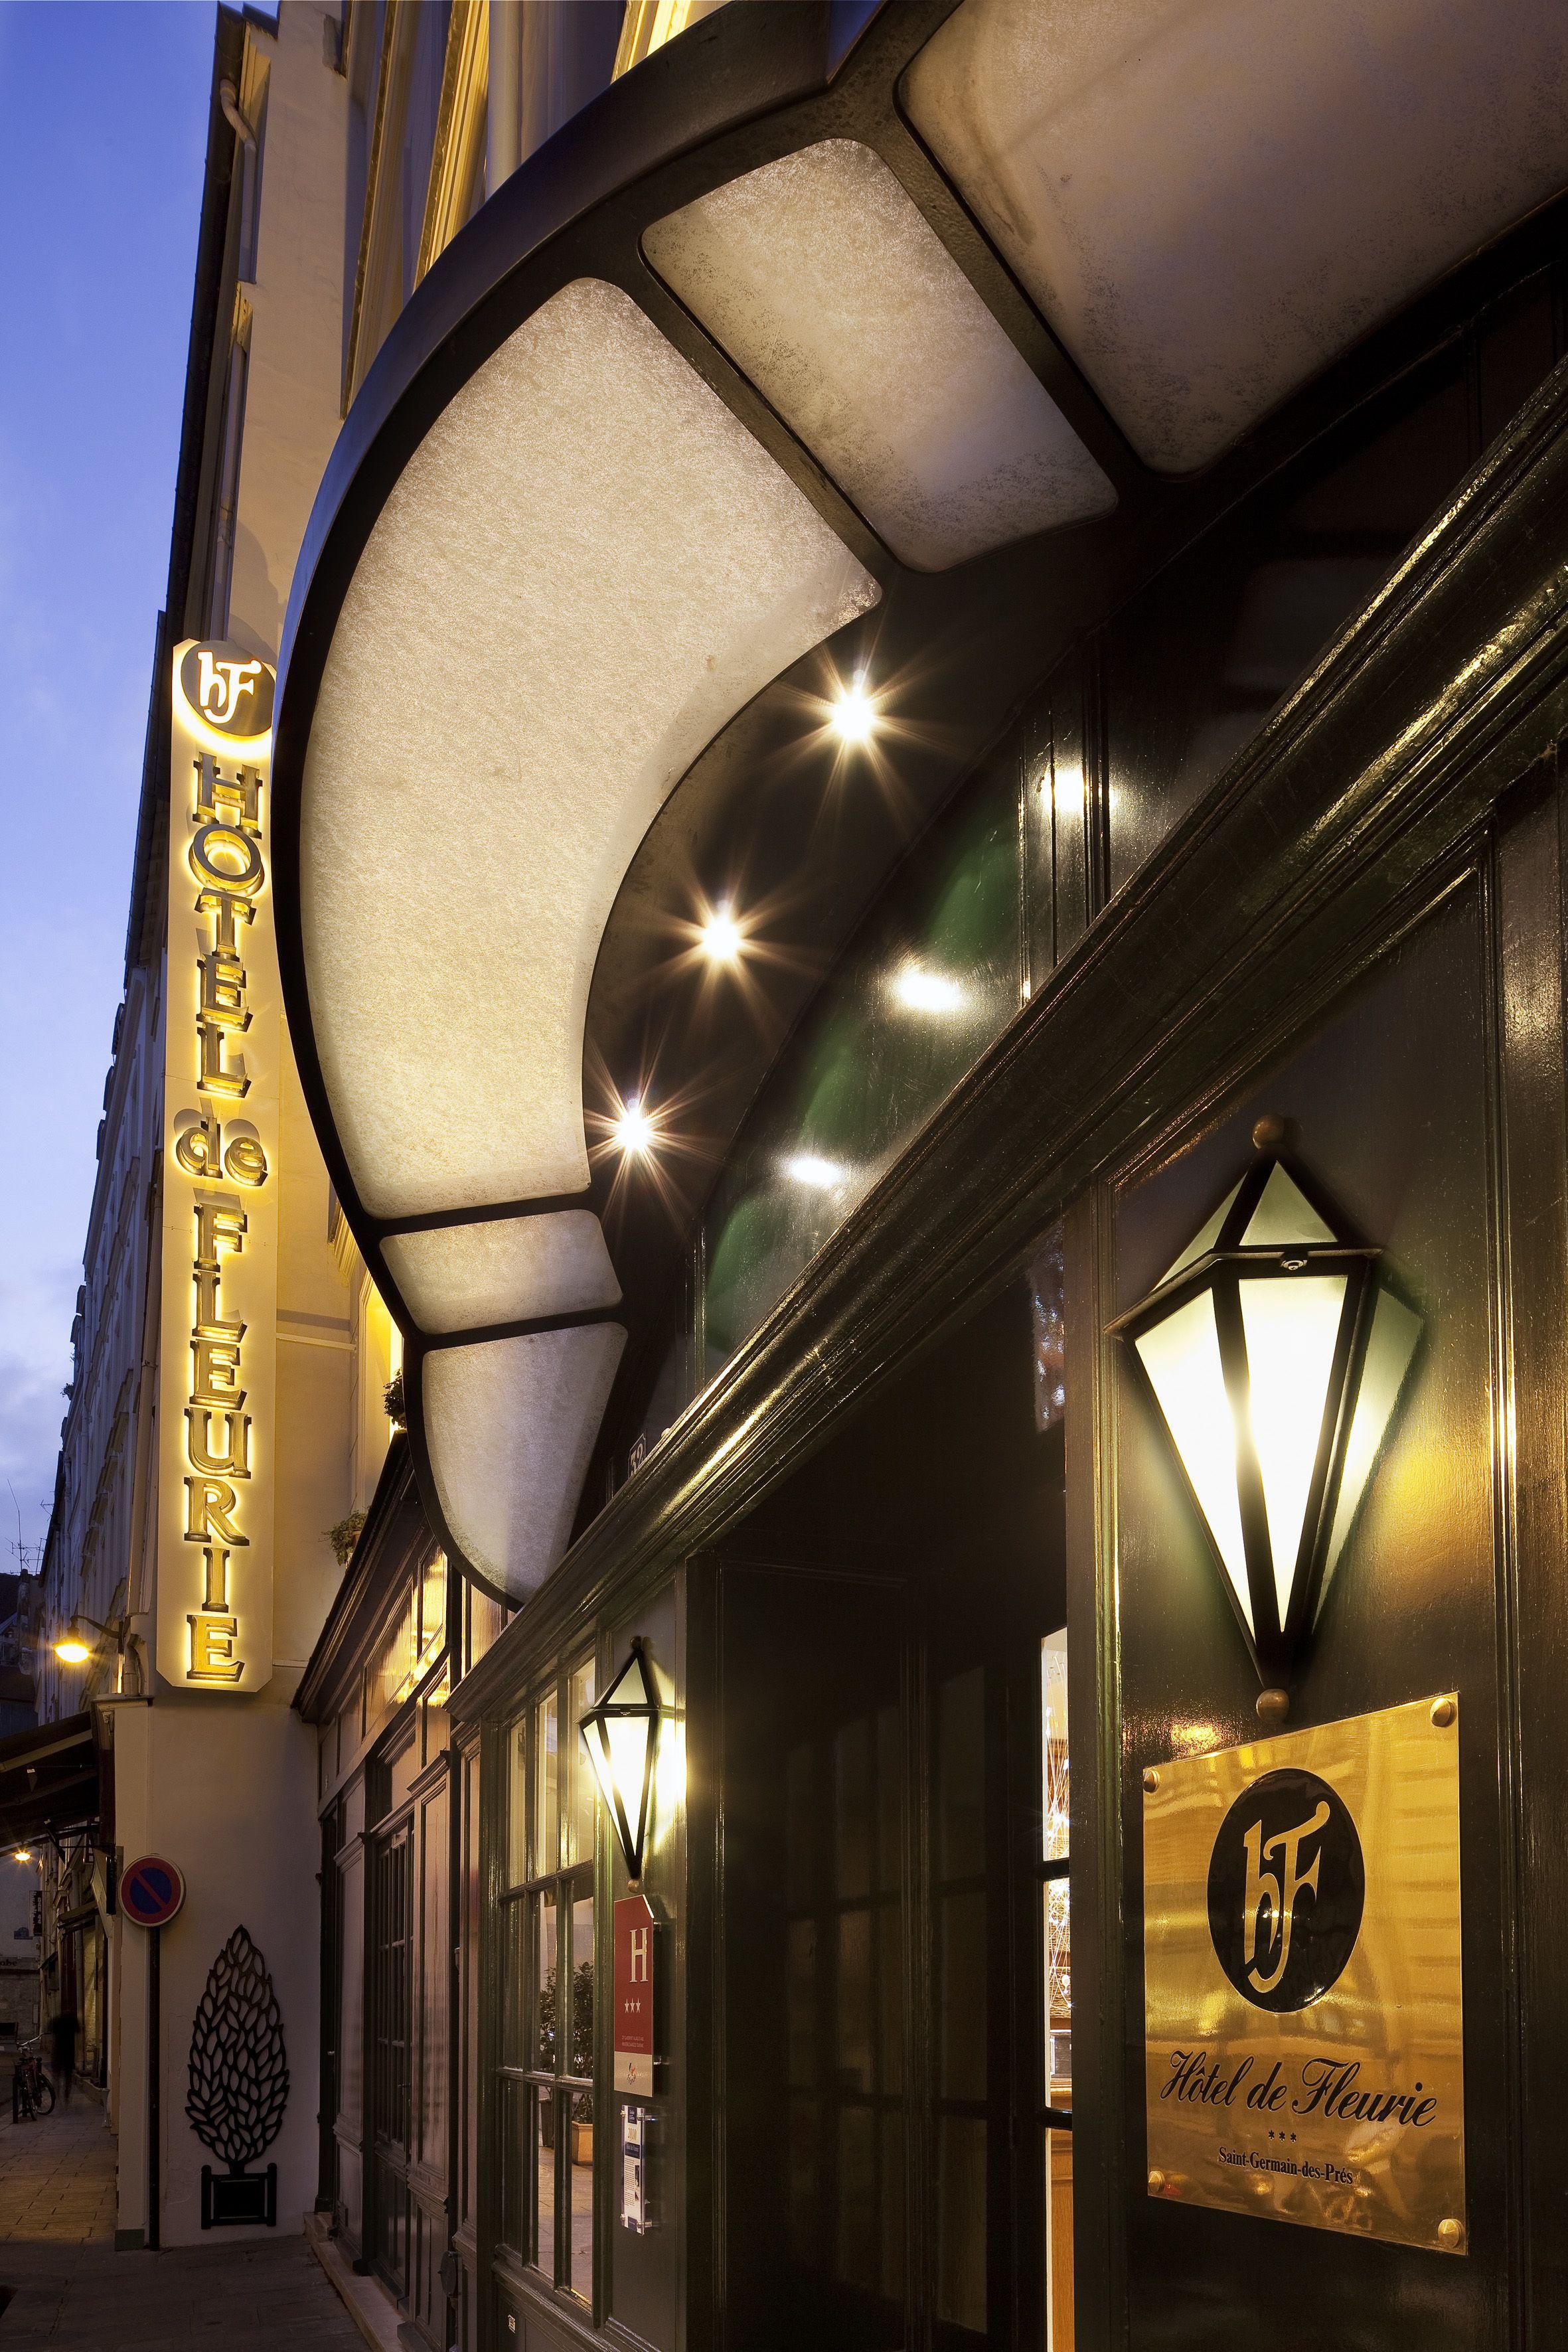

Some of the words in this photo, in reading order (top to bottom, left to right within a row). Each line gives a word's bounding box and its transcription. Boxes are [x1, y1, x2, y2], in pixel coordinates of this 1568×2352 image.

[189, 751, 265, 1098] HOTEL
[176, 1116, 269, 1187] de
[183, 1202, 252, 1683] FLEURIE
[629, 1927, 649, 1983] H
[1160, 2049, 1255, 2106] Hôtel
[1246, 2061, 1288, 2113] de
[1291, 2057, 1438, 2128] Fleurie
[1218, 2146, 1354, 2186] Saint-Germain-des-Prés
